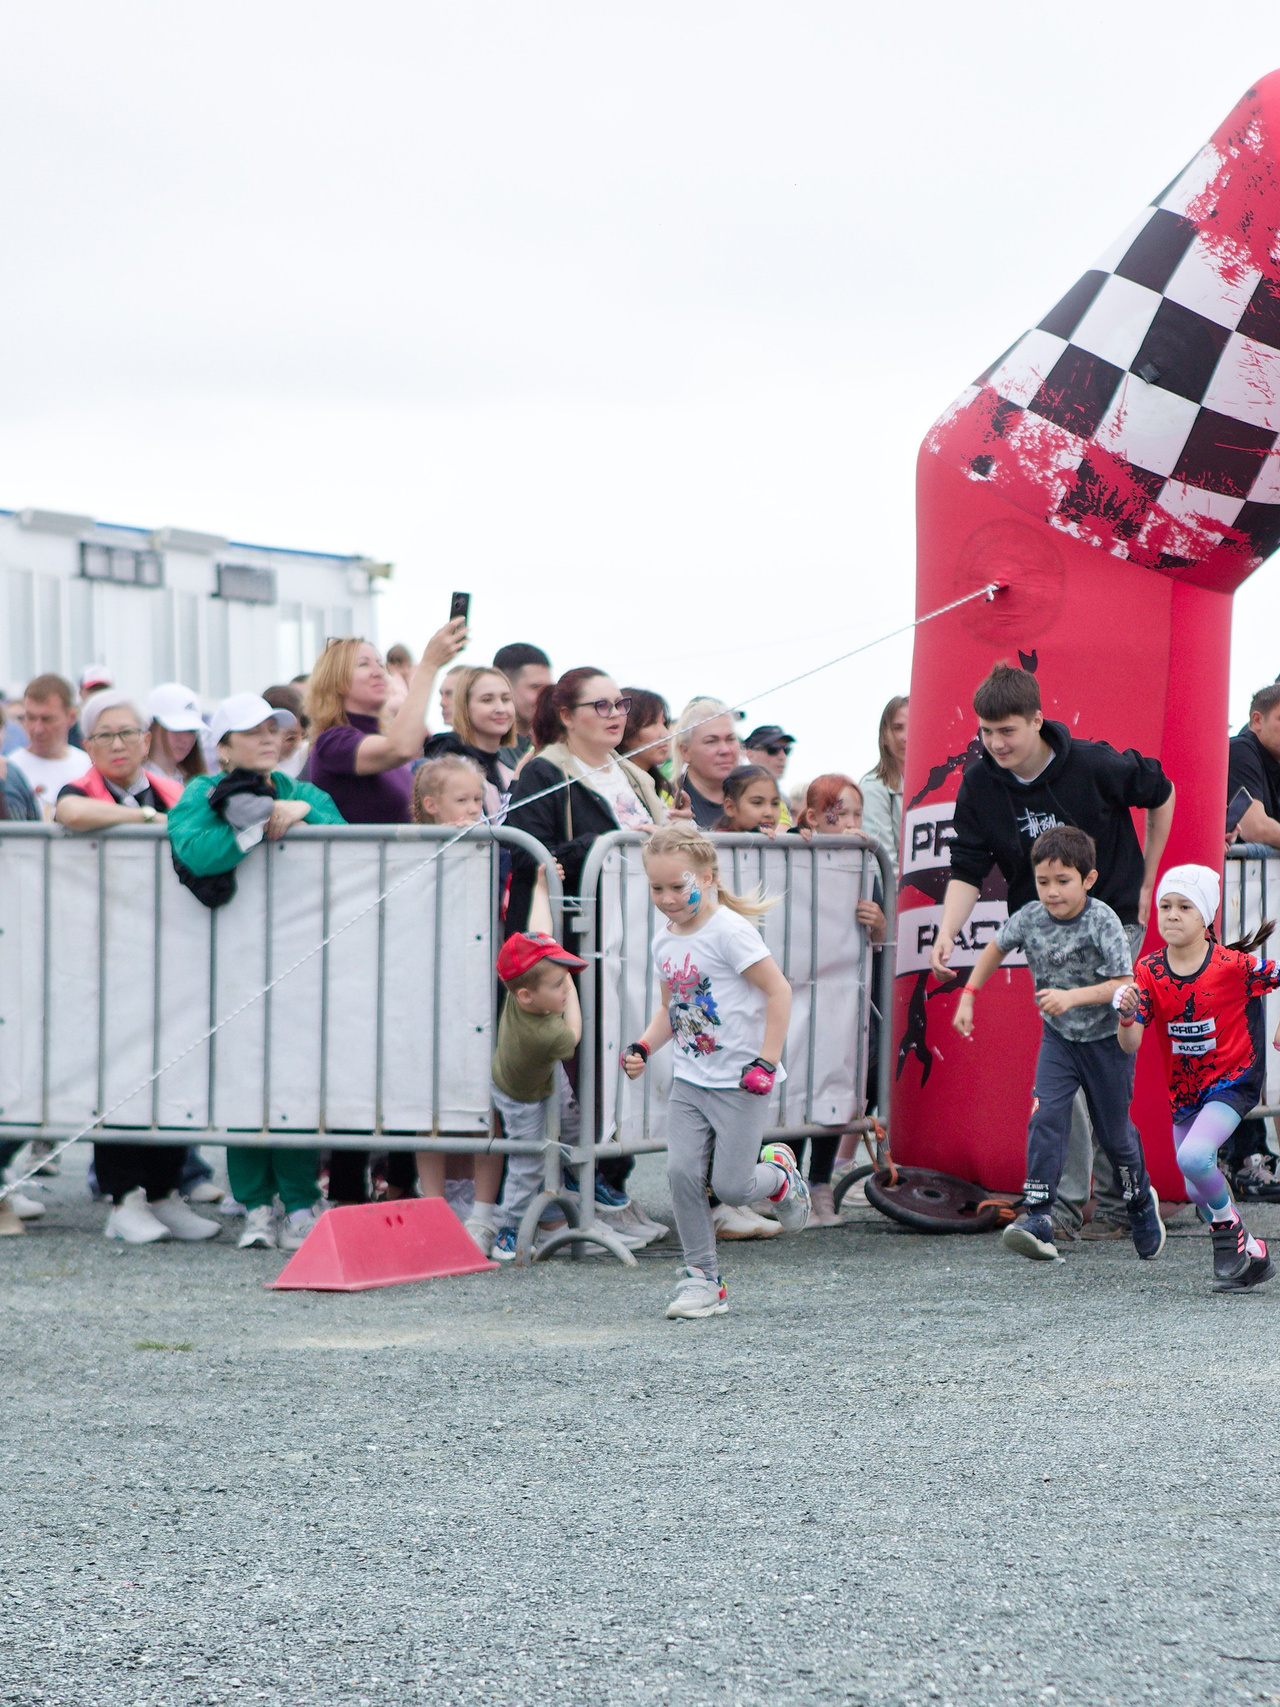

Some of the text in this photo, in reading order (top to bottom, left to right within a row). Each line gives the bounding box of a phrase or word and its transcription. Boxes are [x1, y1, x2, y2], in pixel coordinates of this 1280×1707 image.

[917, 919, 1004, 954] RAC
[1170, 1023, 1210, 1034] PRIDE
[1178, 1044, 1206, 1052] RACE
